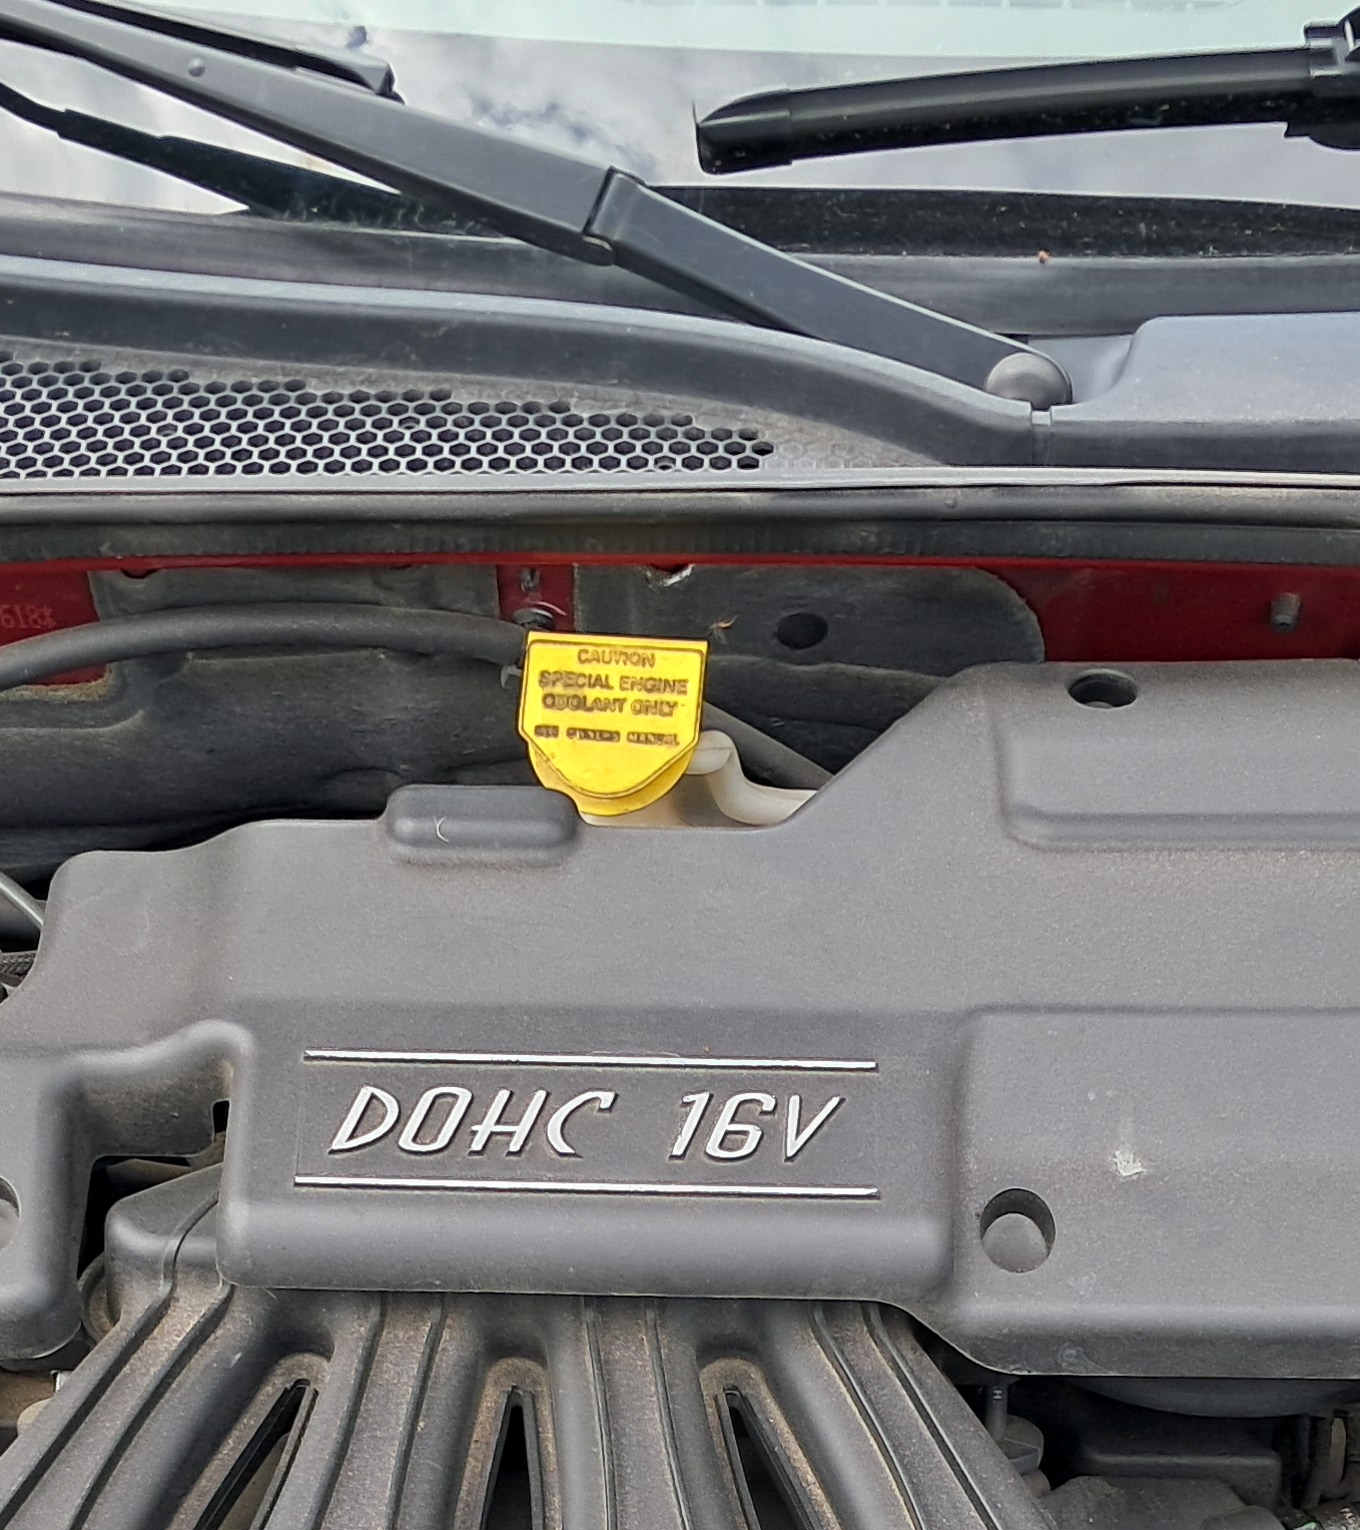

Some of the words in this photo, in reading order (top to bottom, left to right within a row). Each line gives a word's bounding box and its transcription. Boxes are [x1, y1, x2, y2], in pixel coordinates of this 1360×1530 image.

[578, 649, 656, 667] CAUTION
[539, 670, 614, 690] SPECIAL
[619, 676, 689, 695] ENGINE
[630, 700, 680, 717] ONLY
[328, 1083, 619, 1158] DOHC
[667, 1089, 845, 1163] 16V
